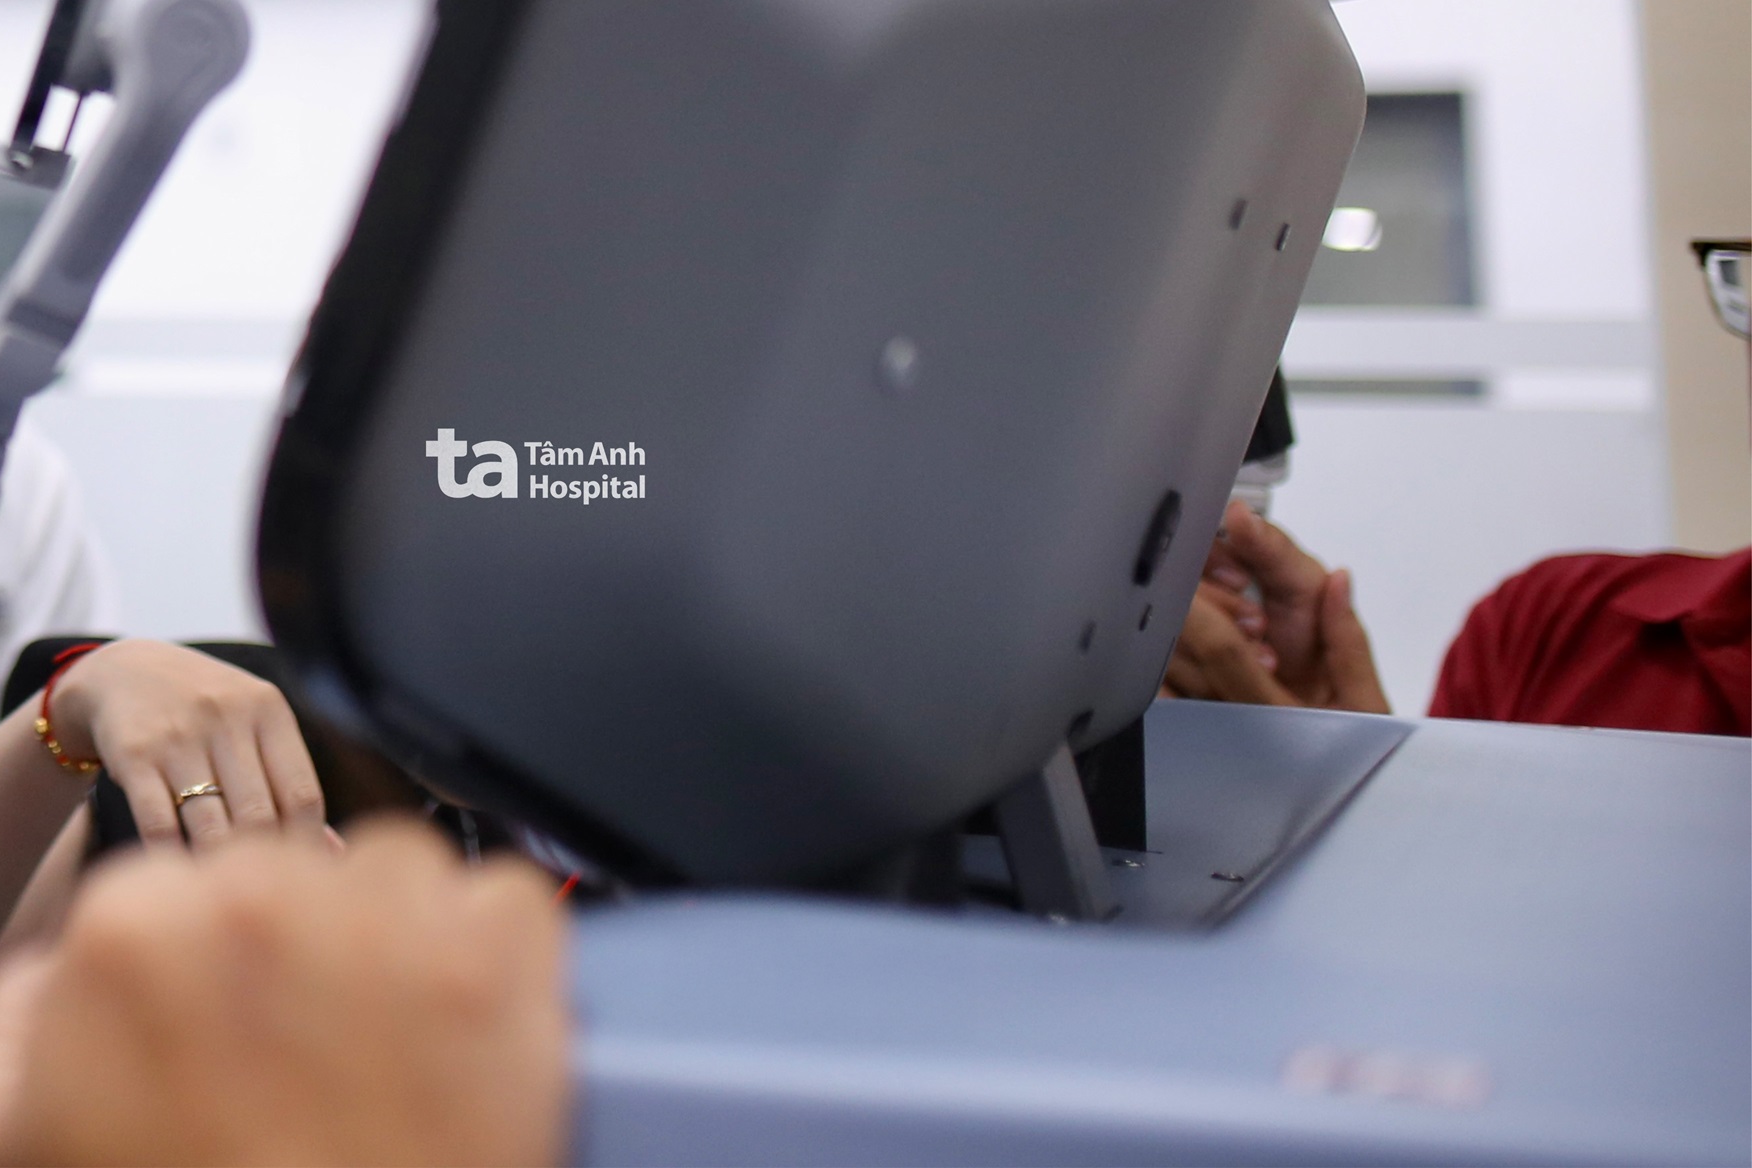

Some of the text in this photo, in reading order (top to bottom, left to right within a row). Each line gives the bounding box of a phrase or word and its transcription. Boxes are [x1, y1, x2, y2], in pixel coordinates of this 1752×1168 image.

[425, 428, 519, 499] ta
[523, 441, 646, 466] Tâm Anh
[529, 473, 646, 505] Hospital
